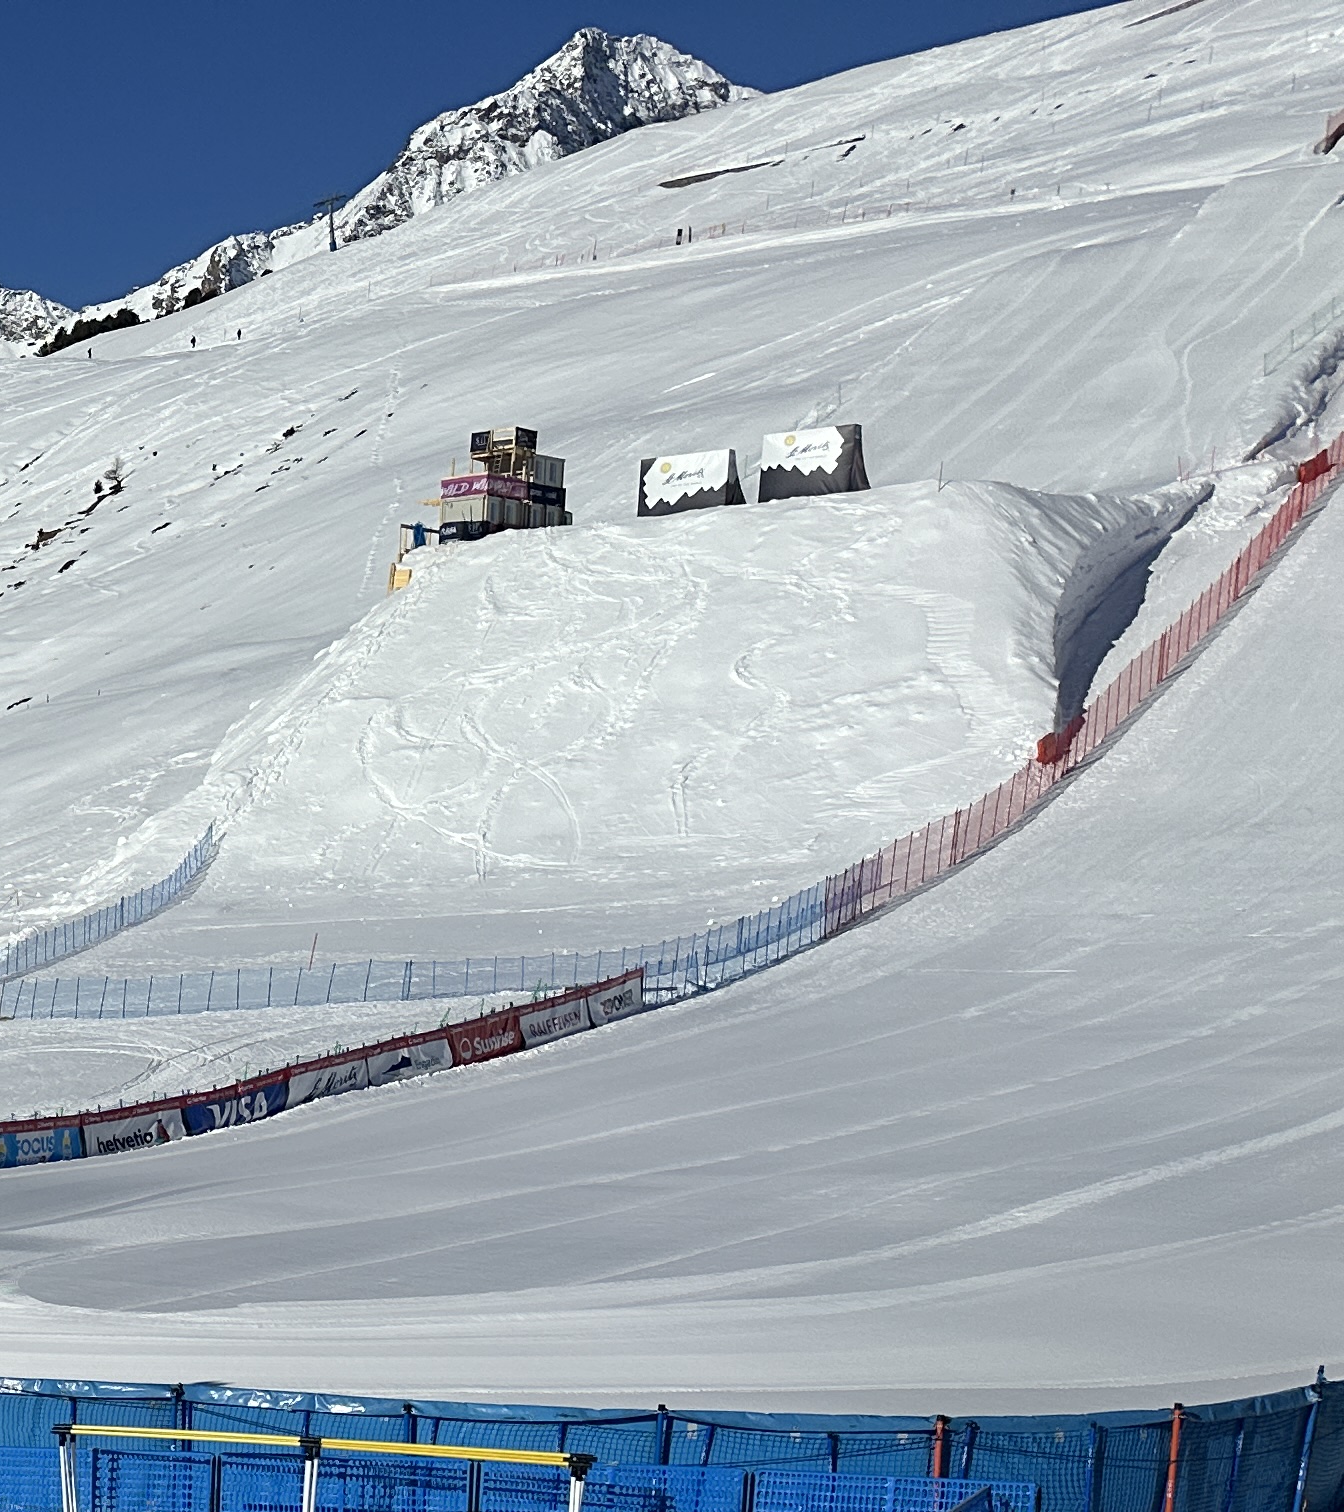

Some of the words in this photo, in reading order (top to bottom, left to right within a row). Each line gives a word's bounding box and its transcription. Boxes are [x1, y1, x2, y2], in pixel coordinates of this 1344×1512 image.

[473, 1029, 515, 1055] Sunrise
[206, 1092, 268, 1128] VISA
[97, 1129, 154, 1153] helvetia
